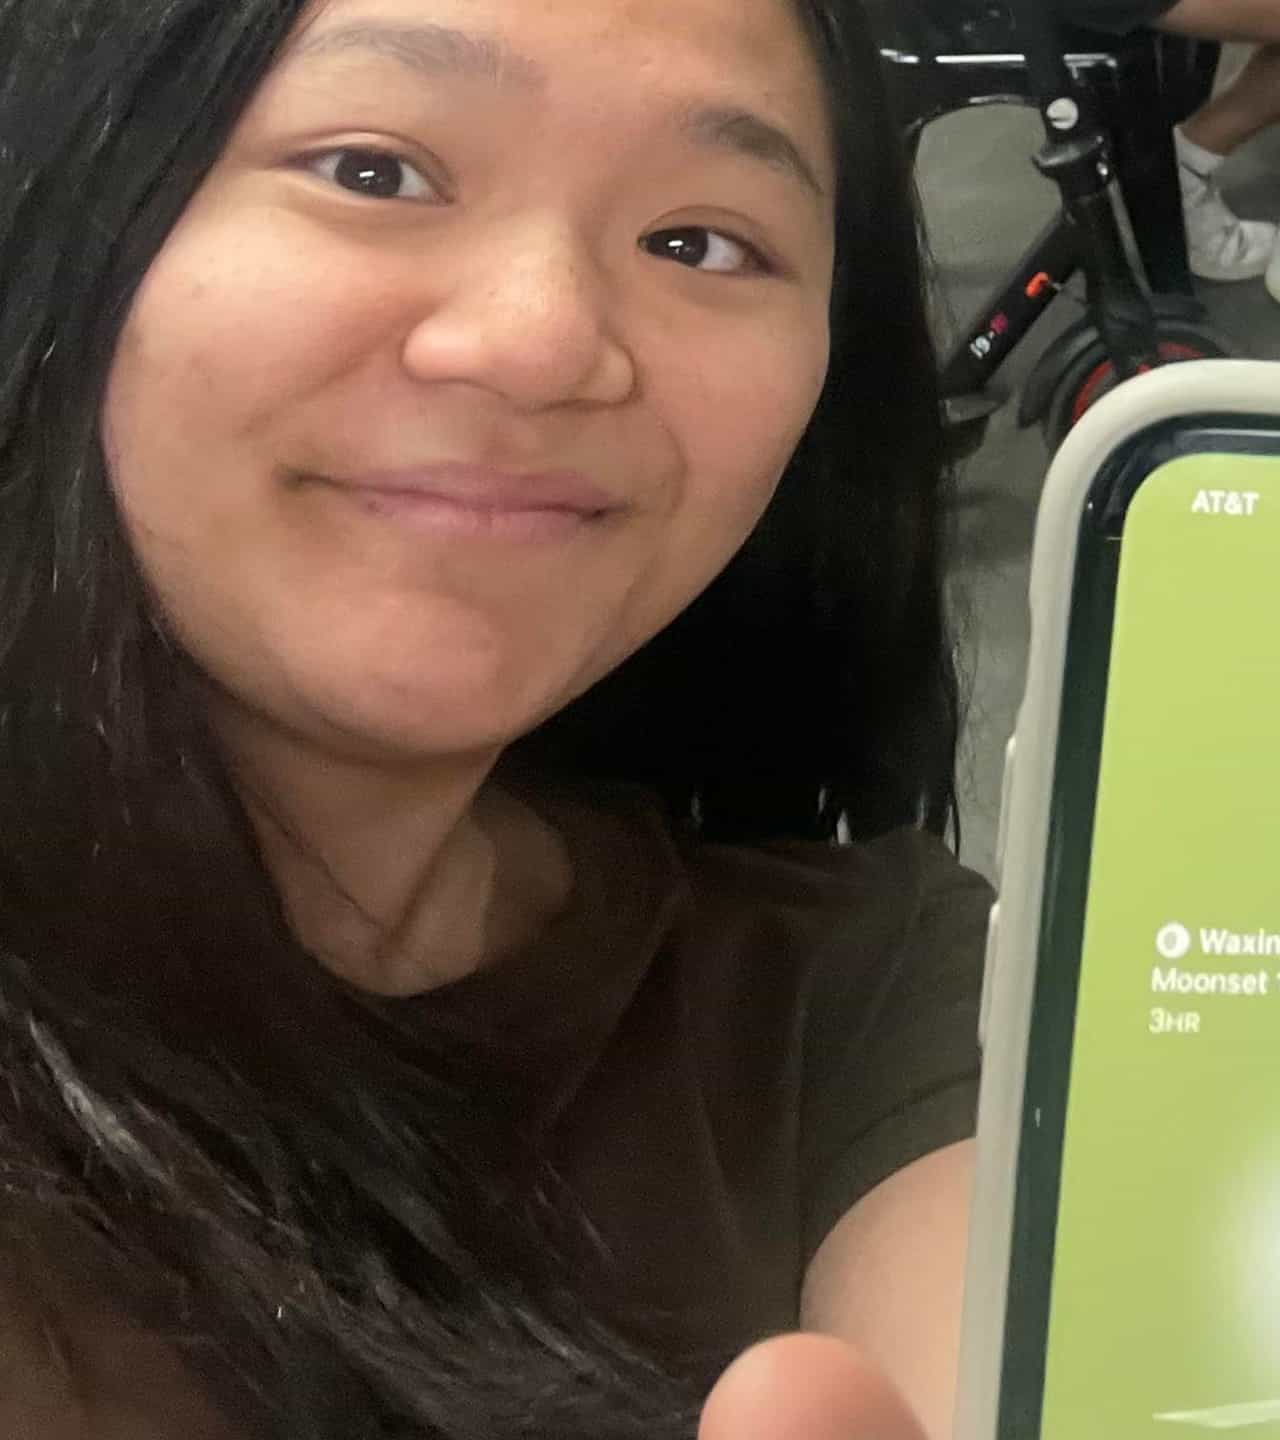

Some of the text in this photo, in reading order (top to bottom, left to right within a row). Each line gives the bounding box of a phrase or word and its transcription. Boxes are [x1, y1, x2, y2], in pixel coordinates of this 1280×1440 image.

[1191, 490, 1259, 517] AT&T
[1151, 967, 1268, 995] Moonset
[1149, 1007, 1200, 1033] 3HR
